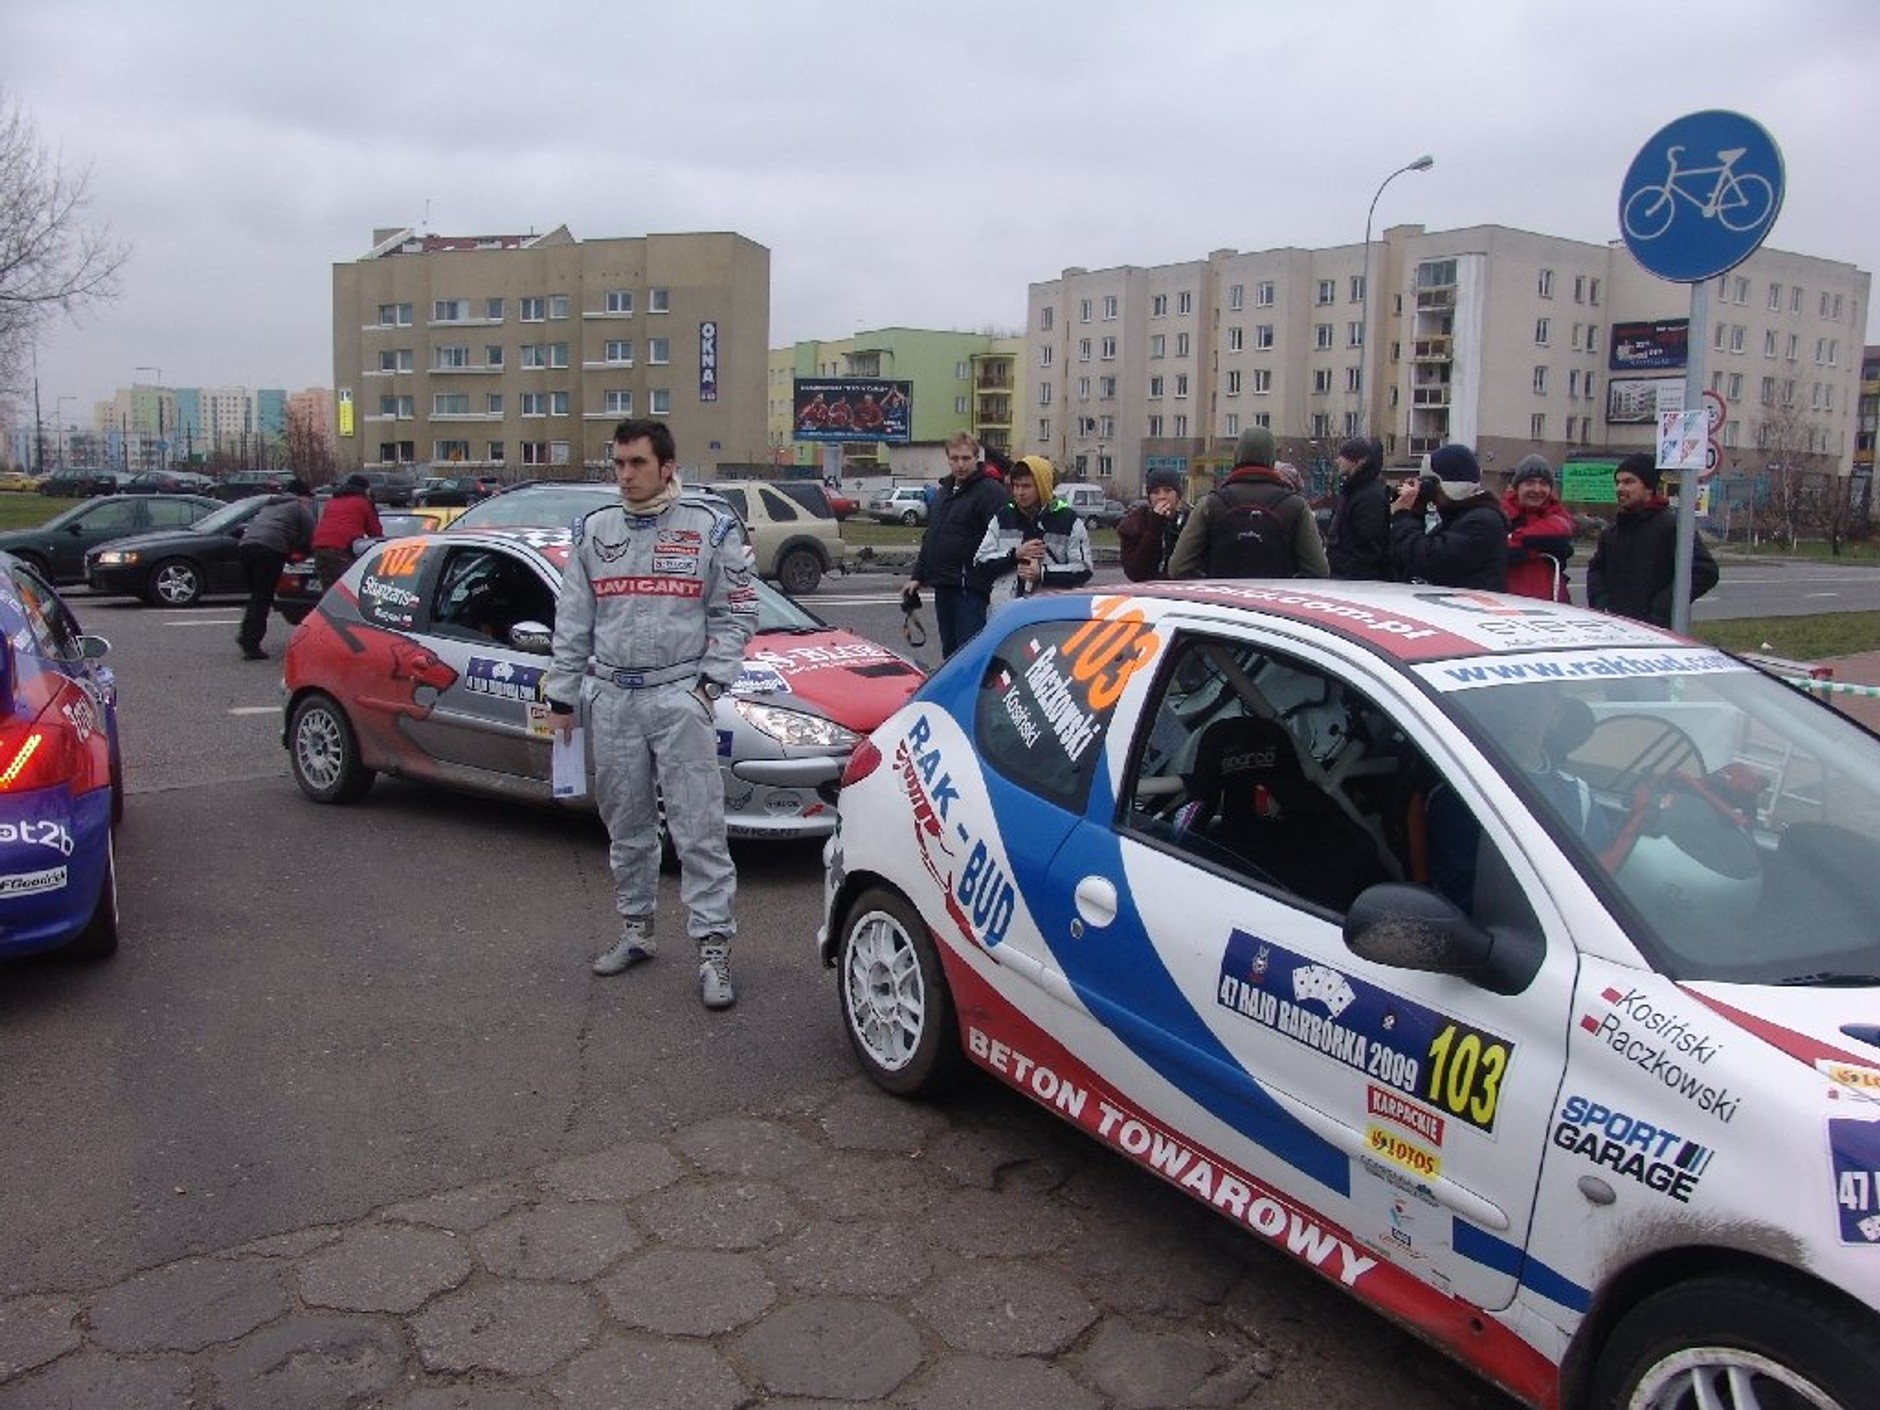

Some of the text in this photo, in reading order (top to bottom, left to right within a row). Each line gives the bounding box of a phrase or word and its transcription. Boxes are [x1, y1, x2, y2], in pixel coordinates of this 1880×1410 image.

[701, 323, 715, 384] OKNA
[378, 540, 427, 576] 102
[1061, 596, 1160, 712] 103
[1023, 643, 1101, 763] Raczkowski
[908, 713, 961, 824] RAK
[956, 838, 1016, 948] BUD
[1219, 974, 1238, 1005] 47
[1276, 998, 1366, 1073] BARBÓRKA
[1368, 1042, 1419, 1092] 2009
[1616, 987, 1724, 1065] Kosiński
[1428, 1025, 1507, 1126] 103
[1595, 1012, 1742, 1124] Raczkowski
[968, 1026, 1377, 1287] BETON TOWAROWY
[1371, 1089, 1440, 1142] KARPACKIE
[1561, 1095, 1681, 1159] SPORT
[1386, 1140, 1436, 1175] LOTOS
[1552, 1122, 1700, 1204] GARAGE
[1838, 1171, 1870, 1211] 47
